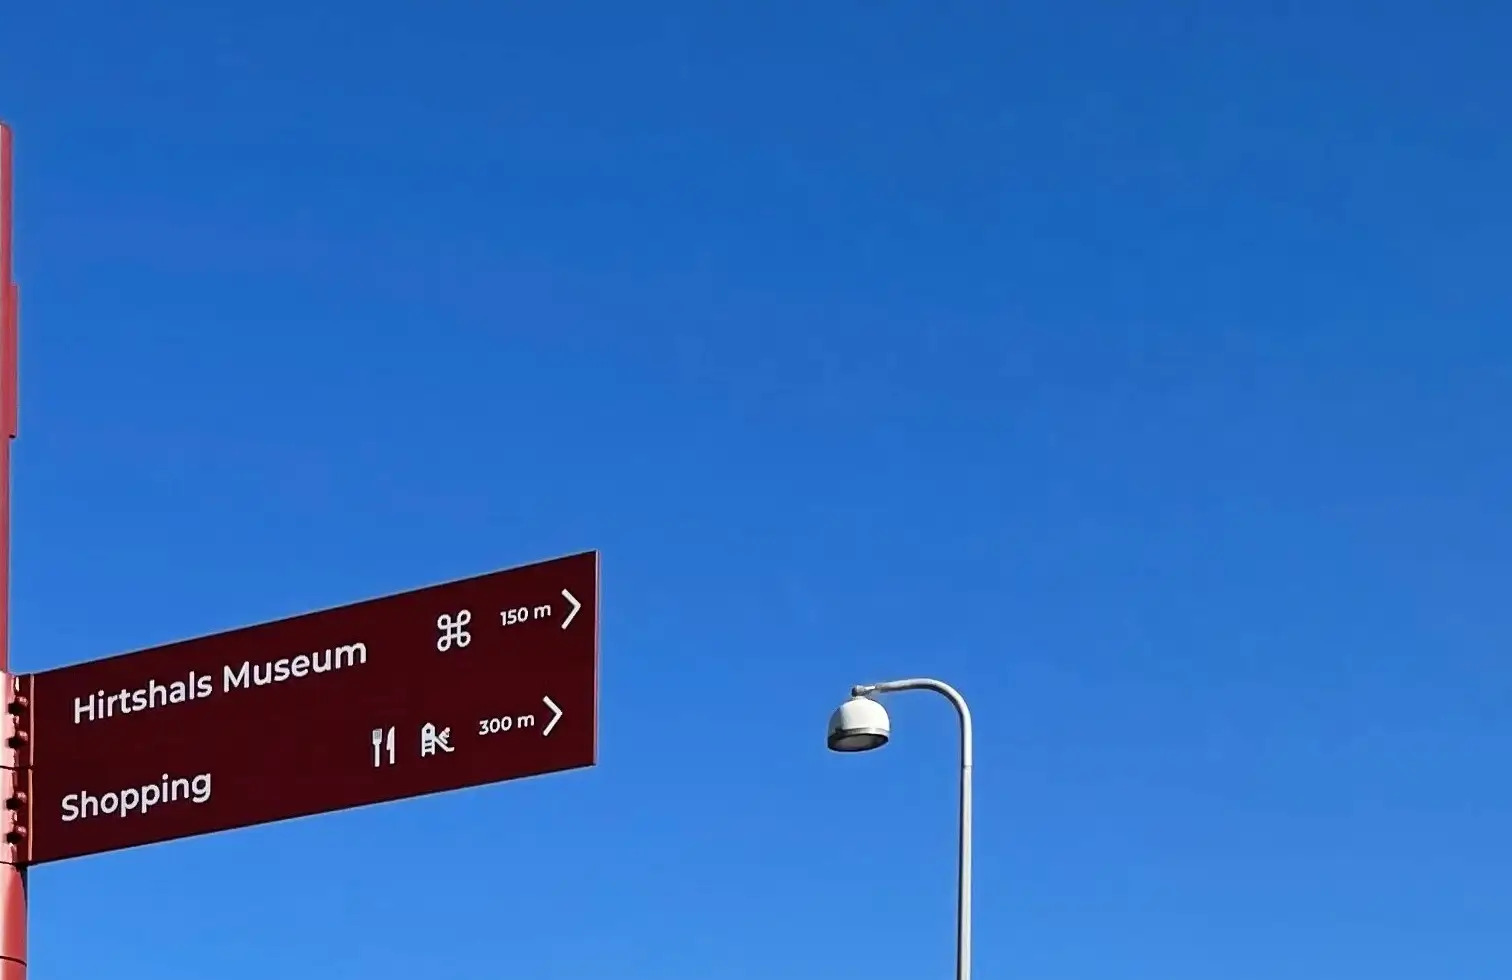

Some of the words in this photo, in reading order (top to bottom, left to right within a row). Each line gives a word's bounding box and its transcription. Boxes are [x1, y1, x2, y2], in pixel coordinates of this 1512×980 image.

[74, 670, 213, 724] Hirtshals
[223, 642, 367, 693] Museum
[499, 606, 529, 627] 150
[533, 604, 552, 620] m
[61, 773, 212, 822] Shopping
[478, 715, 513, 736] 300
[516, 714, 535, 729] m
